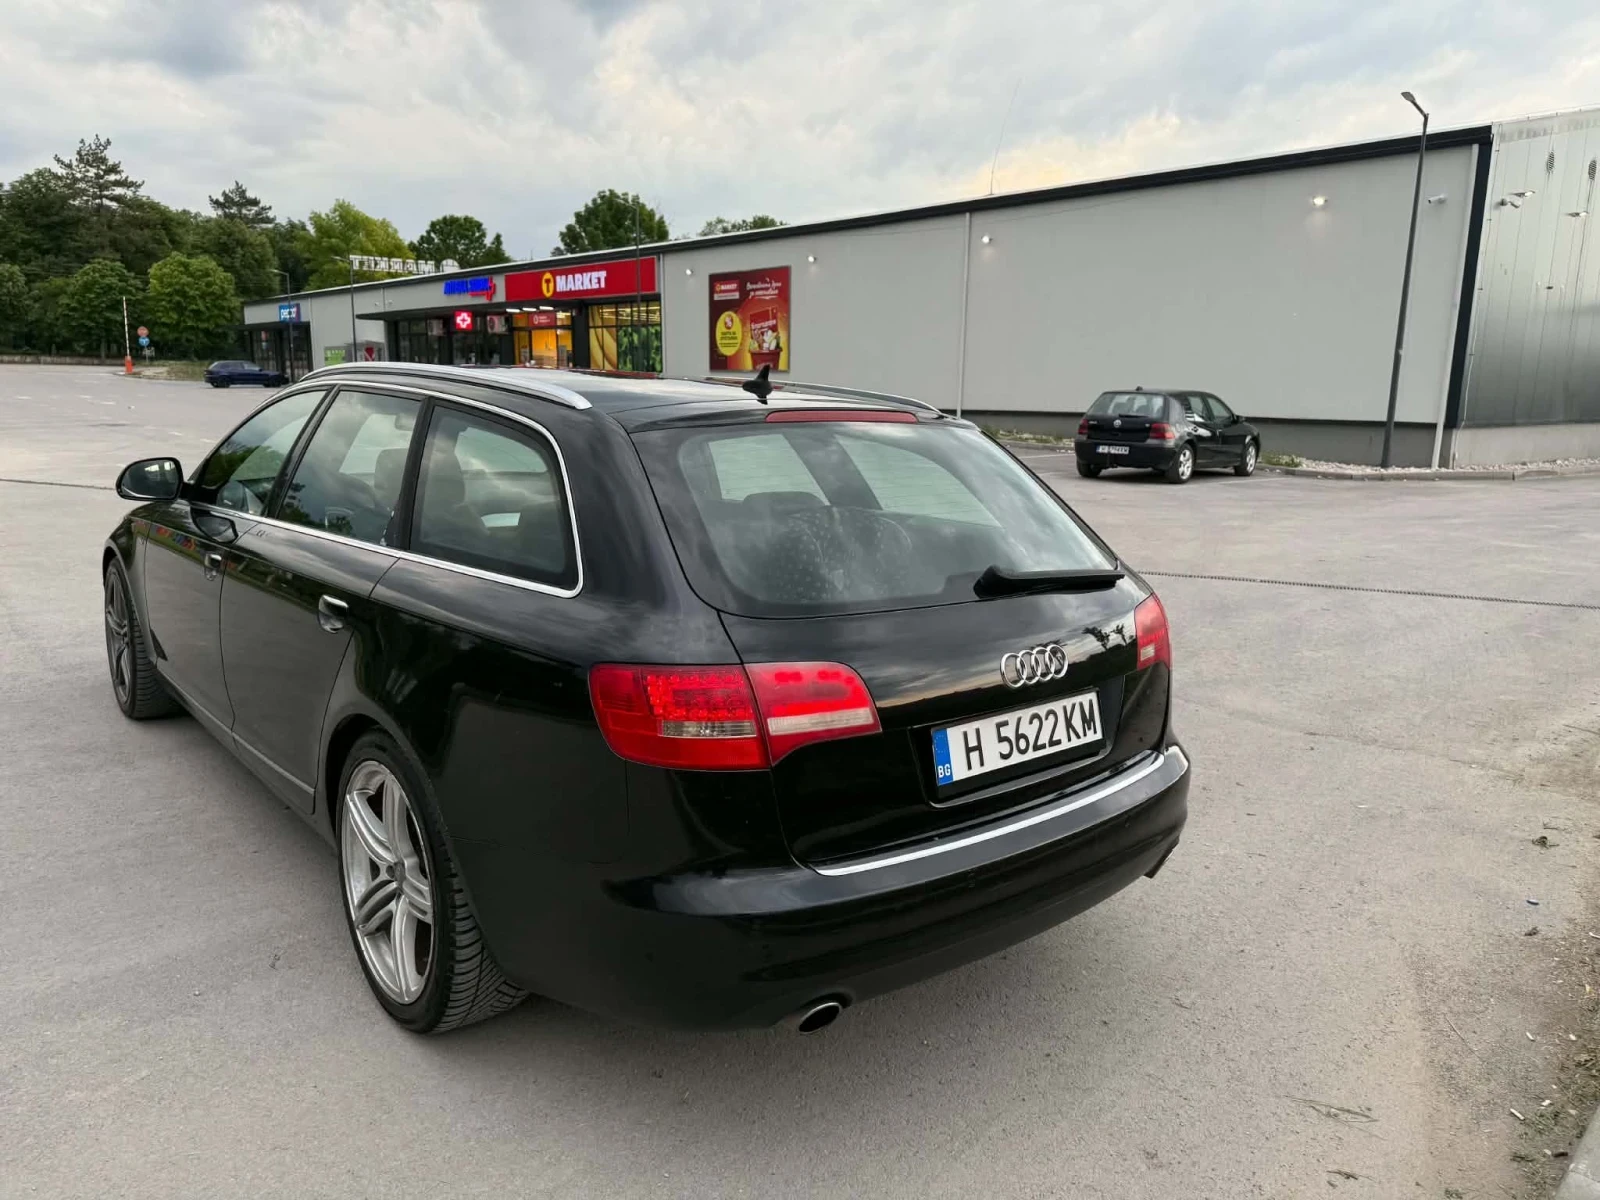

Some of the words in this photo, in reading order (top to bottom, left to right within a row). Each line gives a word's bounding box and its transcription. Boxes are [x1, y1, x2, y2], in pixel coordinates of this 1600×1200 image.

[555, 270, 607, 293] MARKET
[962, 727, 985, 771] H
[938, 764, 951, 778] BG
